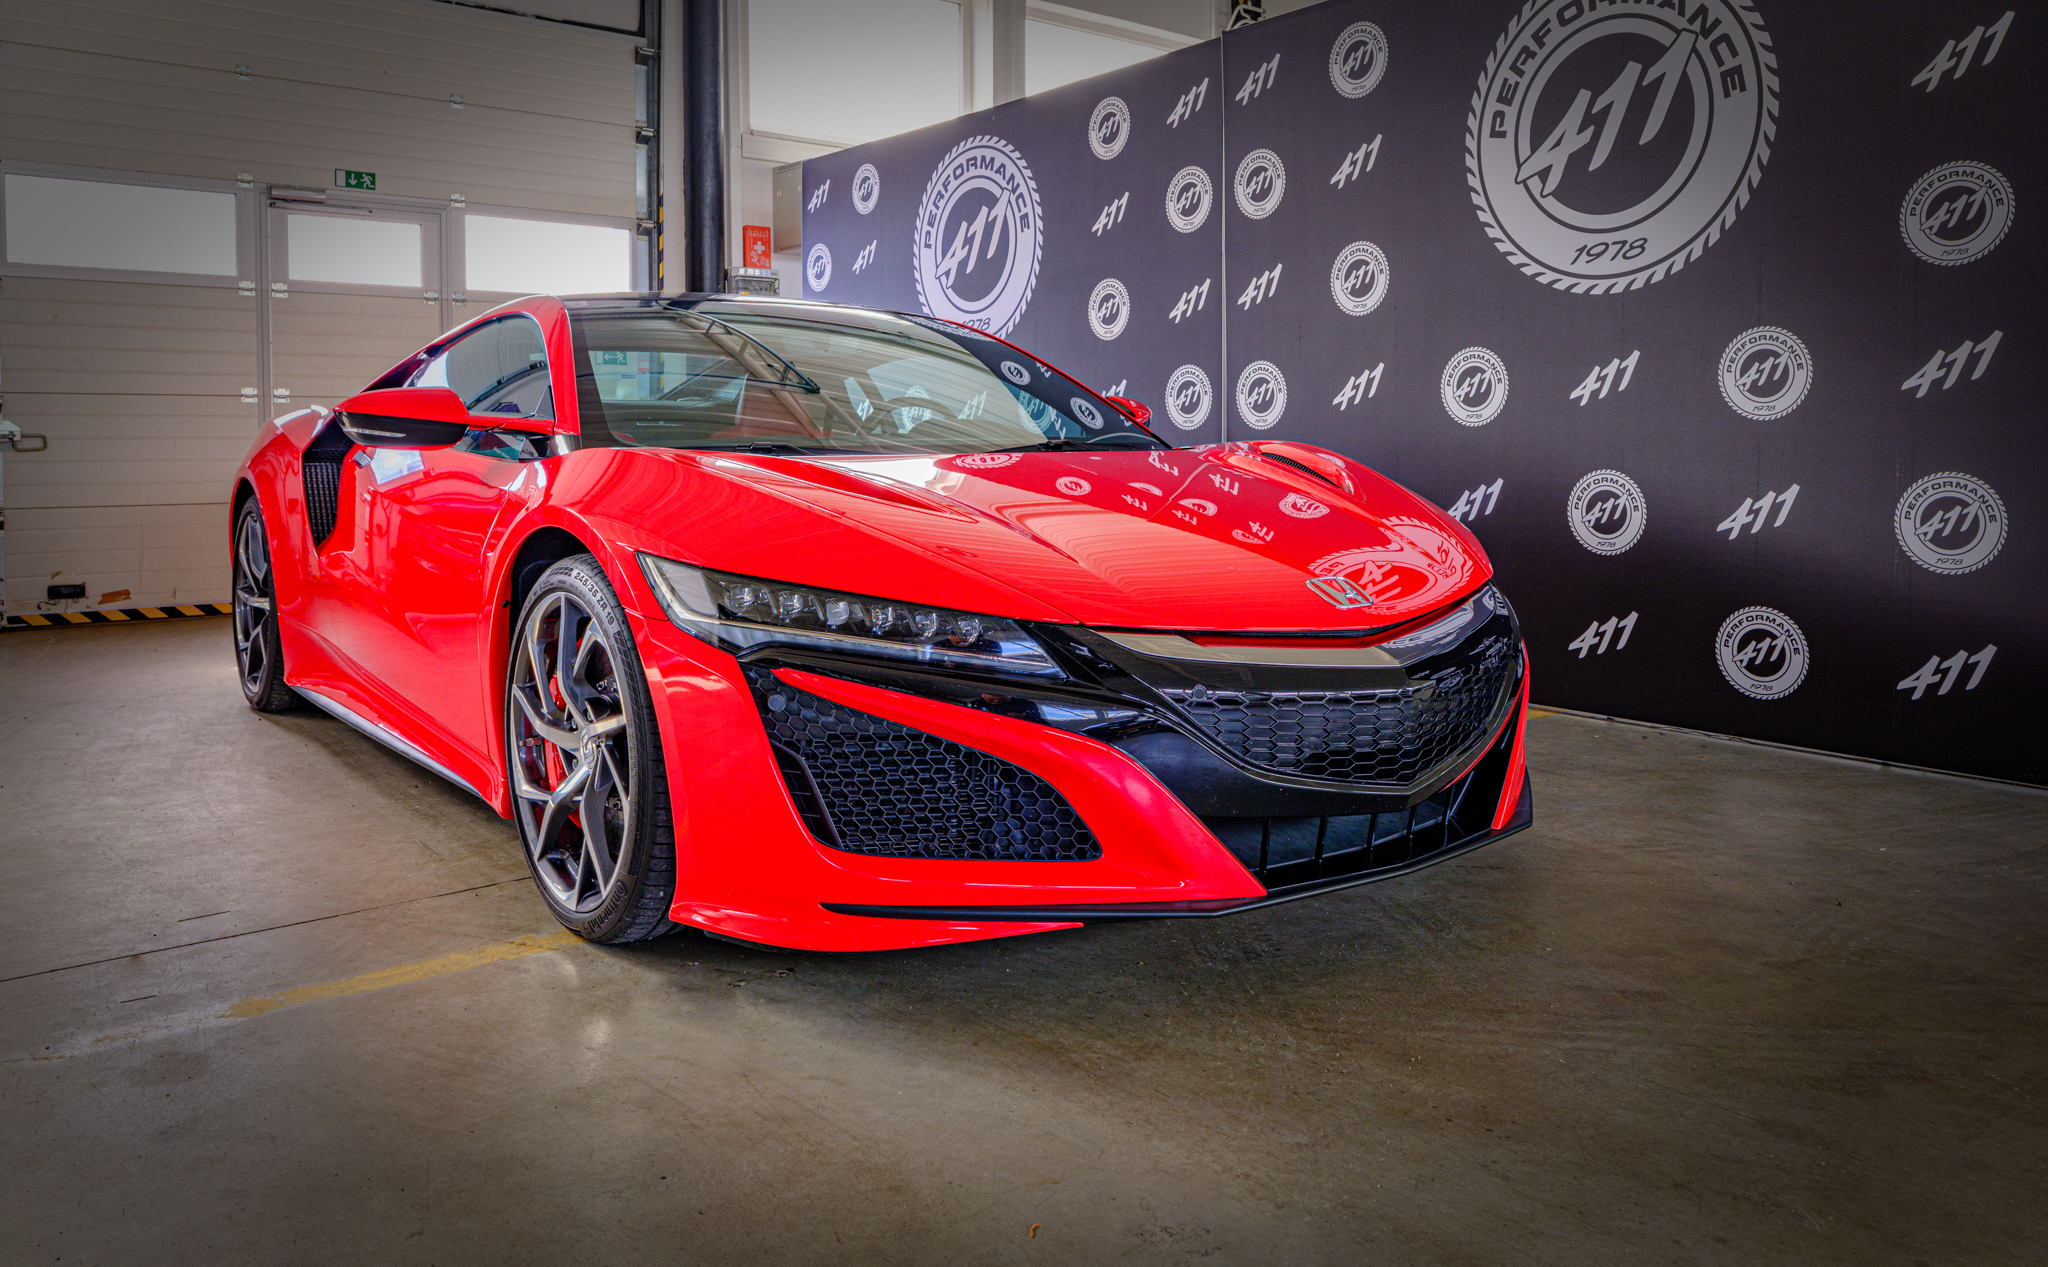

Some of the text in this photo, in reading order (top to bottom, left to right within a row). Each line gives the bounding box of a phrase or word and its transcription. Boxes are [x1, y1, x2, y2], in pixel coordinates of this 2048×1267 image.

[1334, 28, 1383, 65] PERFORMANCE
[1340, 38, 1375, 77] 411
[1911, 10, 2015, 92] 411
[1235, 53, 1280, 105] 411
[1092, 102, 1126, 131] PERFORMANCE
[1166, 77, 1209, 128] 411
[1515, 29, 1698, 198] 411
[1096, 112, 1120, 141] 411
[1238, 155, 1281, 185] PERFORMANCE
[1330, 134, 1382, 189] 411
[807, 179, 830, 213] 411
[1170, 171, 1208, 202] PERFORMANCE
[1174, 182, 1201, 214] 411
[1244, 166, 1274, 199] 411
[1910, 170, 2004, 216] PERFORMANCE
[924, 155, 1030, 249] PERFORMANCE
[1092, 191, 1129, 236] 411
[1919, 185, 1988, 235] 411
[852, 239, 876, 274] 411
[936, 188, 1011, 288] 411
[1570, 238, 1648, 265] 1978
[1941, 248, 1969, 257] 1978
[1336, 248, 1384, 280] PERFORMANCE
[1341, 259, 1376, 294] 411
[1092, 283, 1126, 310] PERFORMANCE
[1169, 278, 1211, 324] 411
[1237, 263, 1282, 310] 411
[1096, 294, 1120, 322] 411
[1447, 354, 1502, 386] PERFORMANCE
[1726, 335, 1804, 373] PERFORMANCE
[1734, 350, 1791, 391] 411
[1902, 329, 2004, 399] 411
[1170, 370, 1208, 397] PERFORMANCE
[1174, 381, 1201, 409] 411
[1241, 367, 1282, 394] PERFORMANCE
[1246, 378, 1275, 408] 411
[1332, 362, 1384, 411] 411
[1452, 366, 1494, 402] 411
[1569, 350, 1640, 406] 411
[1447, 477, 1504, 521] 411
[1575, 477, 1639, 512] PERFORMANCE
[1581, 493, 1628, 527] 411
[1717, 483, 1800, 540] 411
[1904, 481, 1997, 523] PERFORMANCE
[1914, 500, 1982, 540] 411
[574, 572, 599, 597] 245/35
[597, 596, 607, 612] ZR
[606, 612, 614, 625] 19
[1568, 610, 1638, 658] 411
[1724, 615, 1800, 655] PERFORMANCE
[1732, 633, 1788, 668] 411
[1898, 643, 1998, 700] 411
